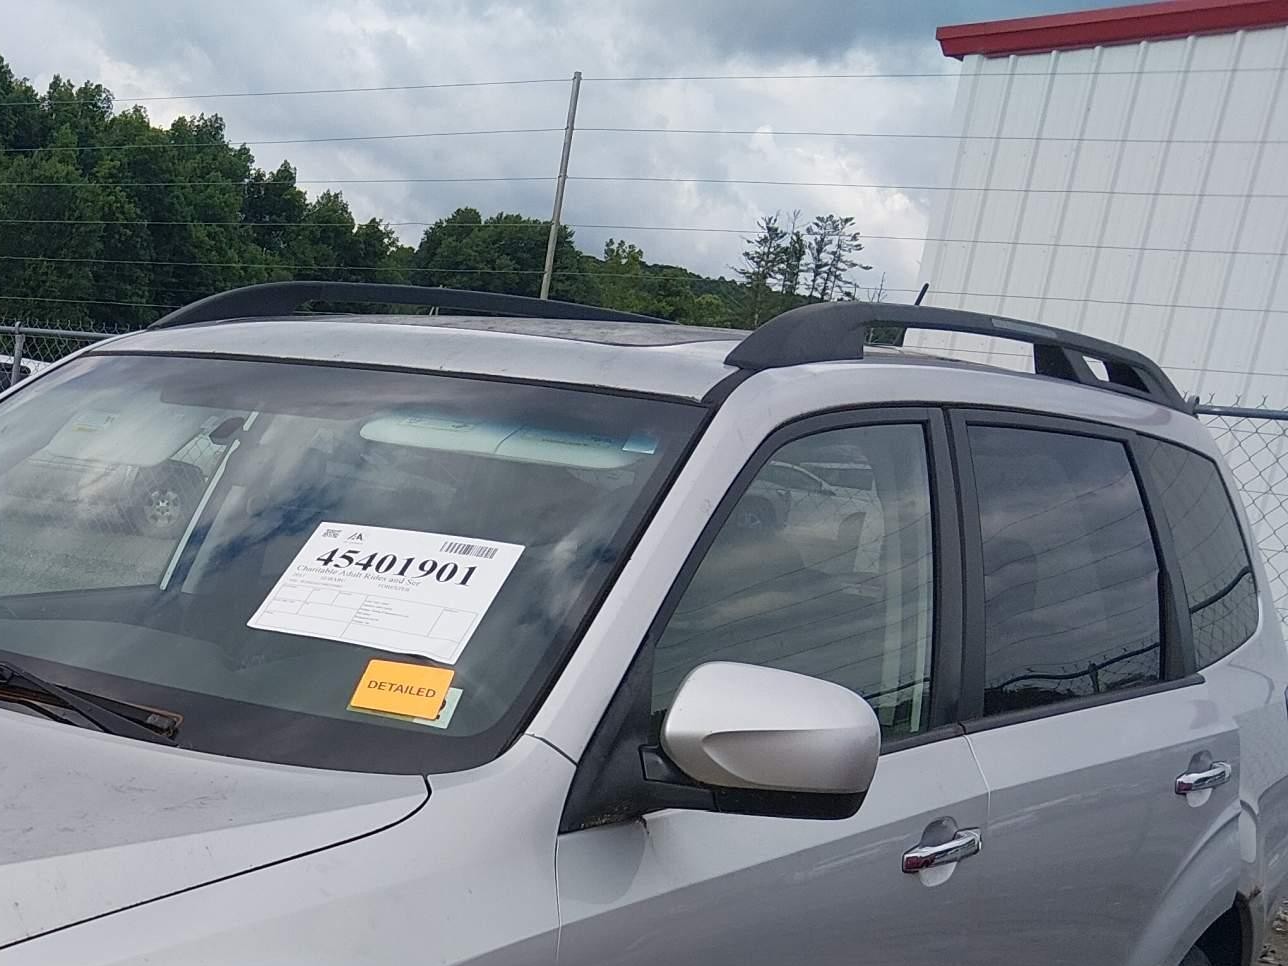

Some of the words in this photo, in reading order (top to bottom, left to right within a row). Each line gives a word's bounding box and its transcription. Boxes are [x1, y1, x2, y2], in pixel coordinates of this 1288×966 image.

[296, 563, 339, 576] Charitable
[340, 568, 363, 579] Adult
[363, 573, 387, 584] Rides
[388, 575, 405, 585] and
[406, 578, 422, 588] Ser
[316, 547, 477, 587] 45401901
[367, 679, 436, 698] DETAILED
